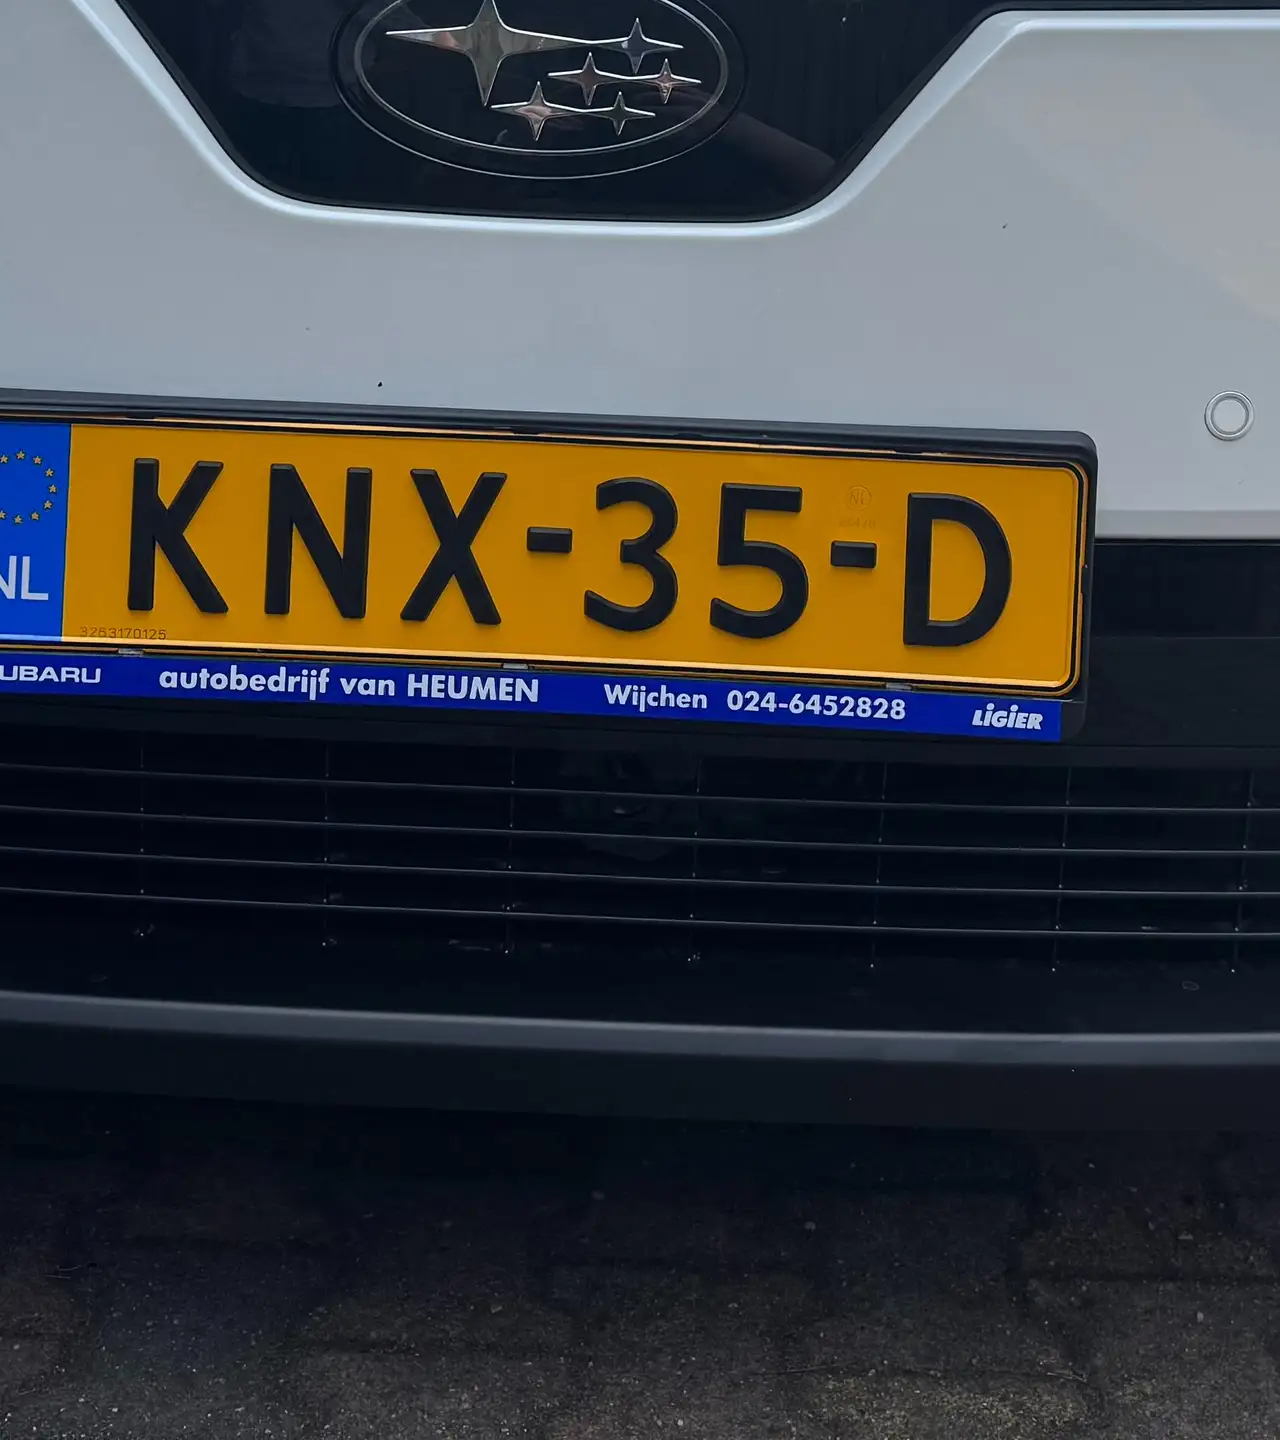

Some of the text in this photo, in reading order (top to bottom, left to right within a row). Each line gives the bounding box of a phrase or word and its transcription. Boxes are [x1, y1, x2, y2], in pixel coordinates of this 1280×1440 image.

[127, 457, 1013, 648] KNX-35-D
[158, 664, 540, 703] autobedrijf van HEUMEN
[603, 683, 907, 721] Wijchen 024-6452828
